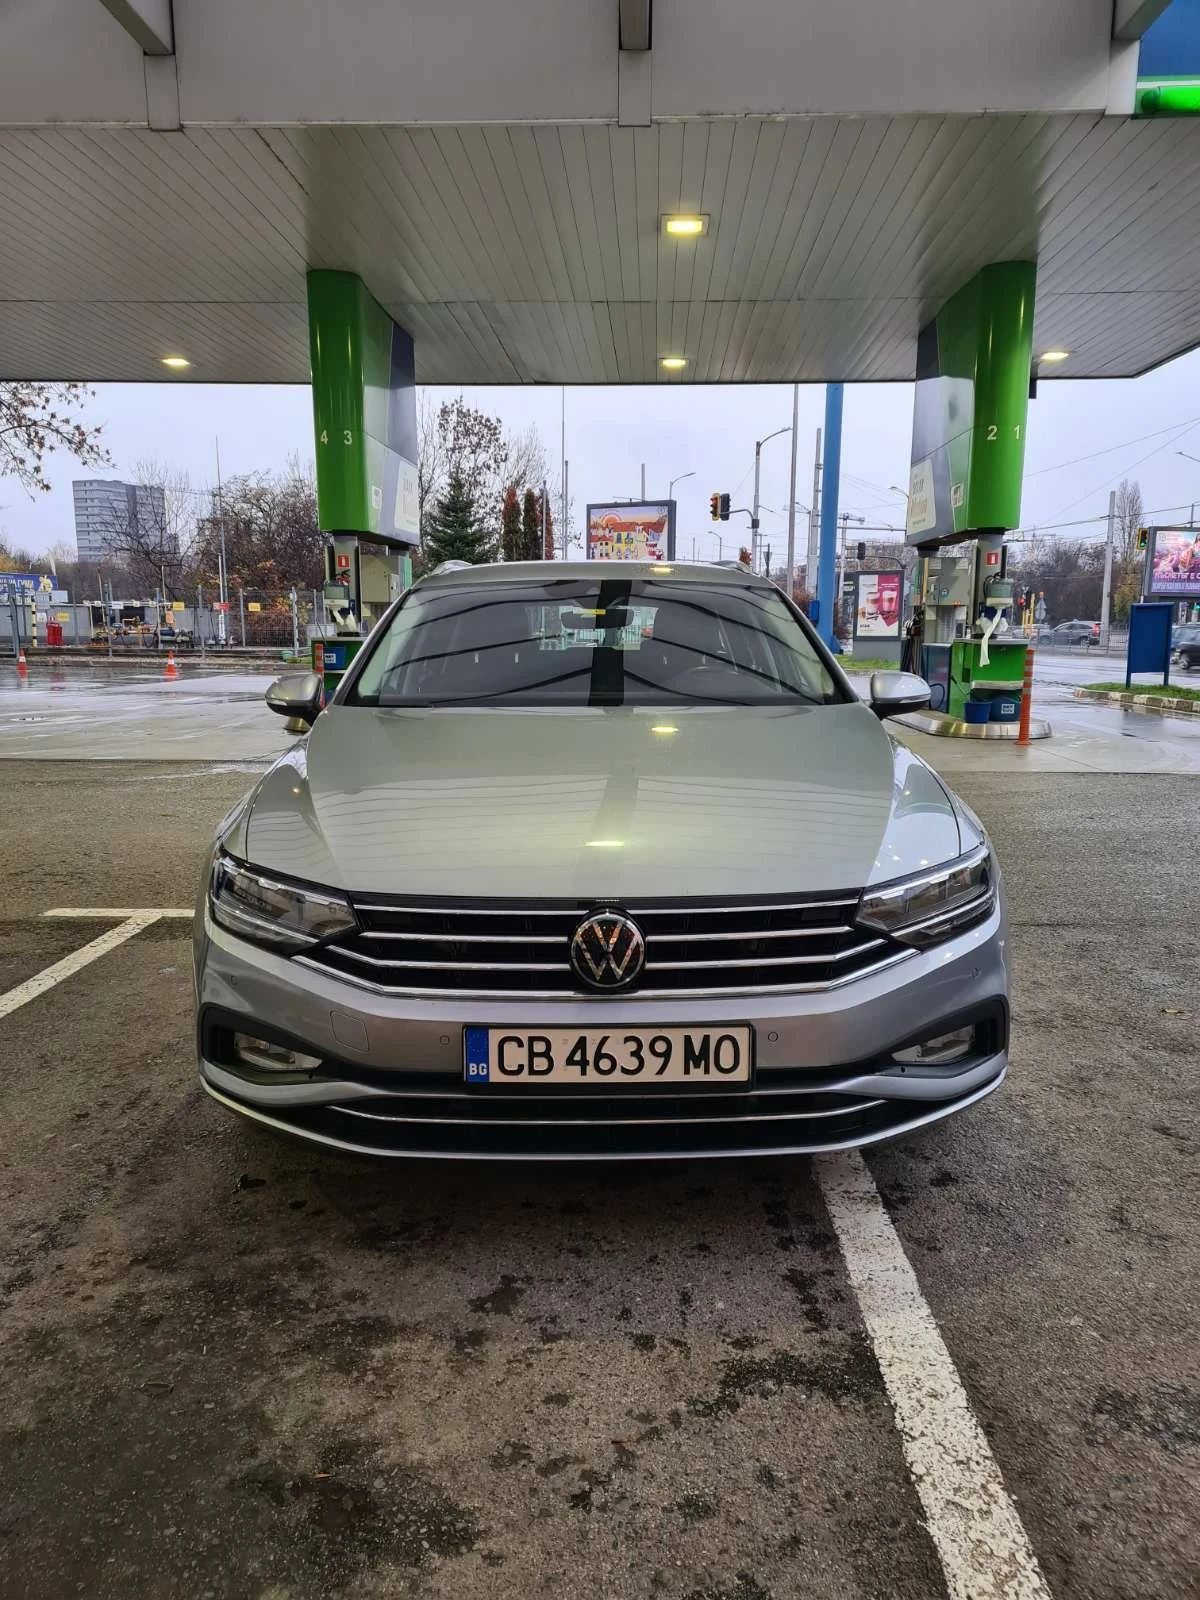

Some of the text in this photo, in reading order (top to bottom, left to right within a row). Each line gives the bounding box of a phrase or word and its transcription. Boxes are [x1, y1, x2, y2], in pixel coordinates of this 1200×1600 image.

[320, 430, 353, 445] 4 3
[987, 424, 1021, 440] 2 1
[498, 1034, 740, 1076] CB 4639 MO
[469, 1063, 488, 1075] BG
